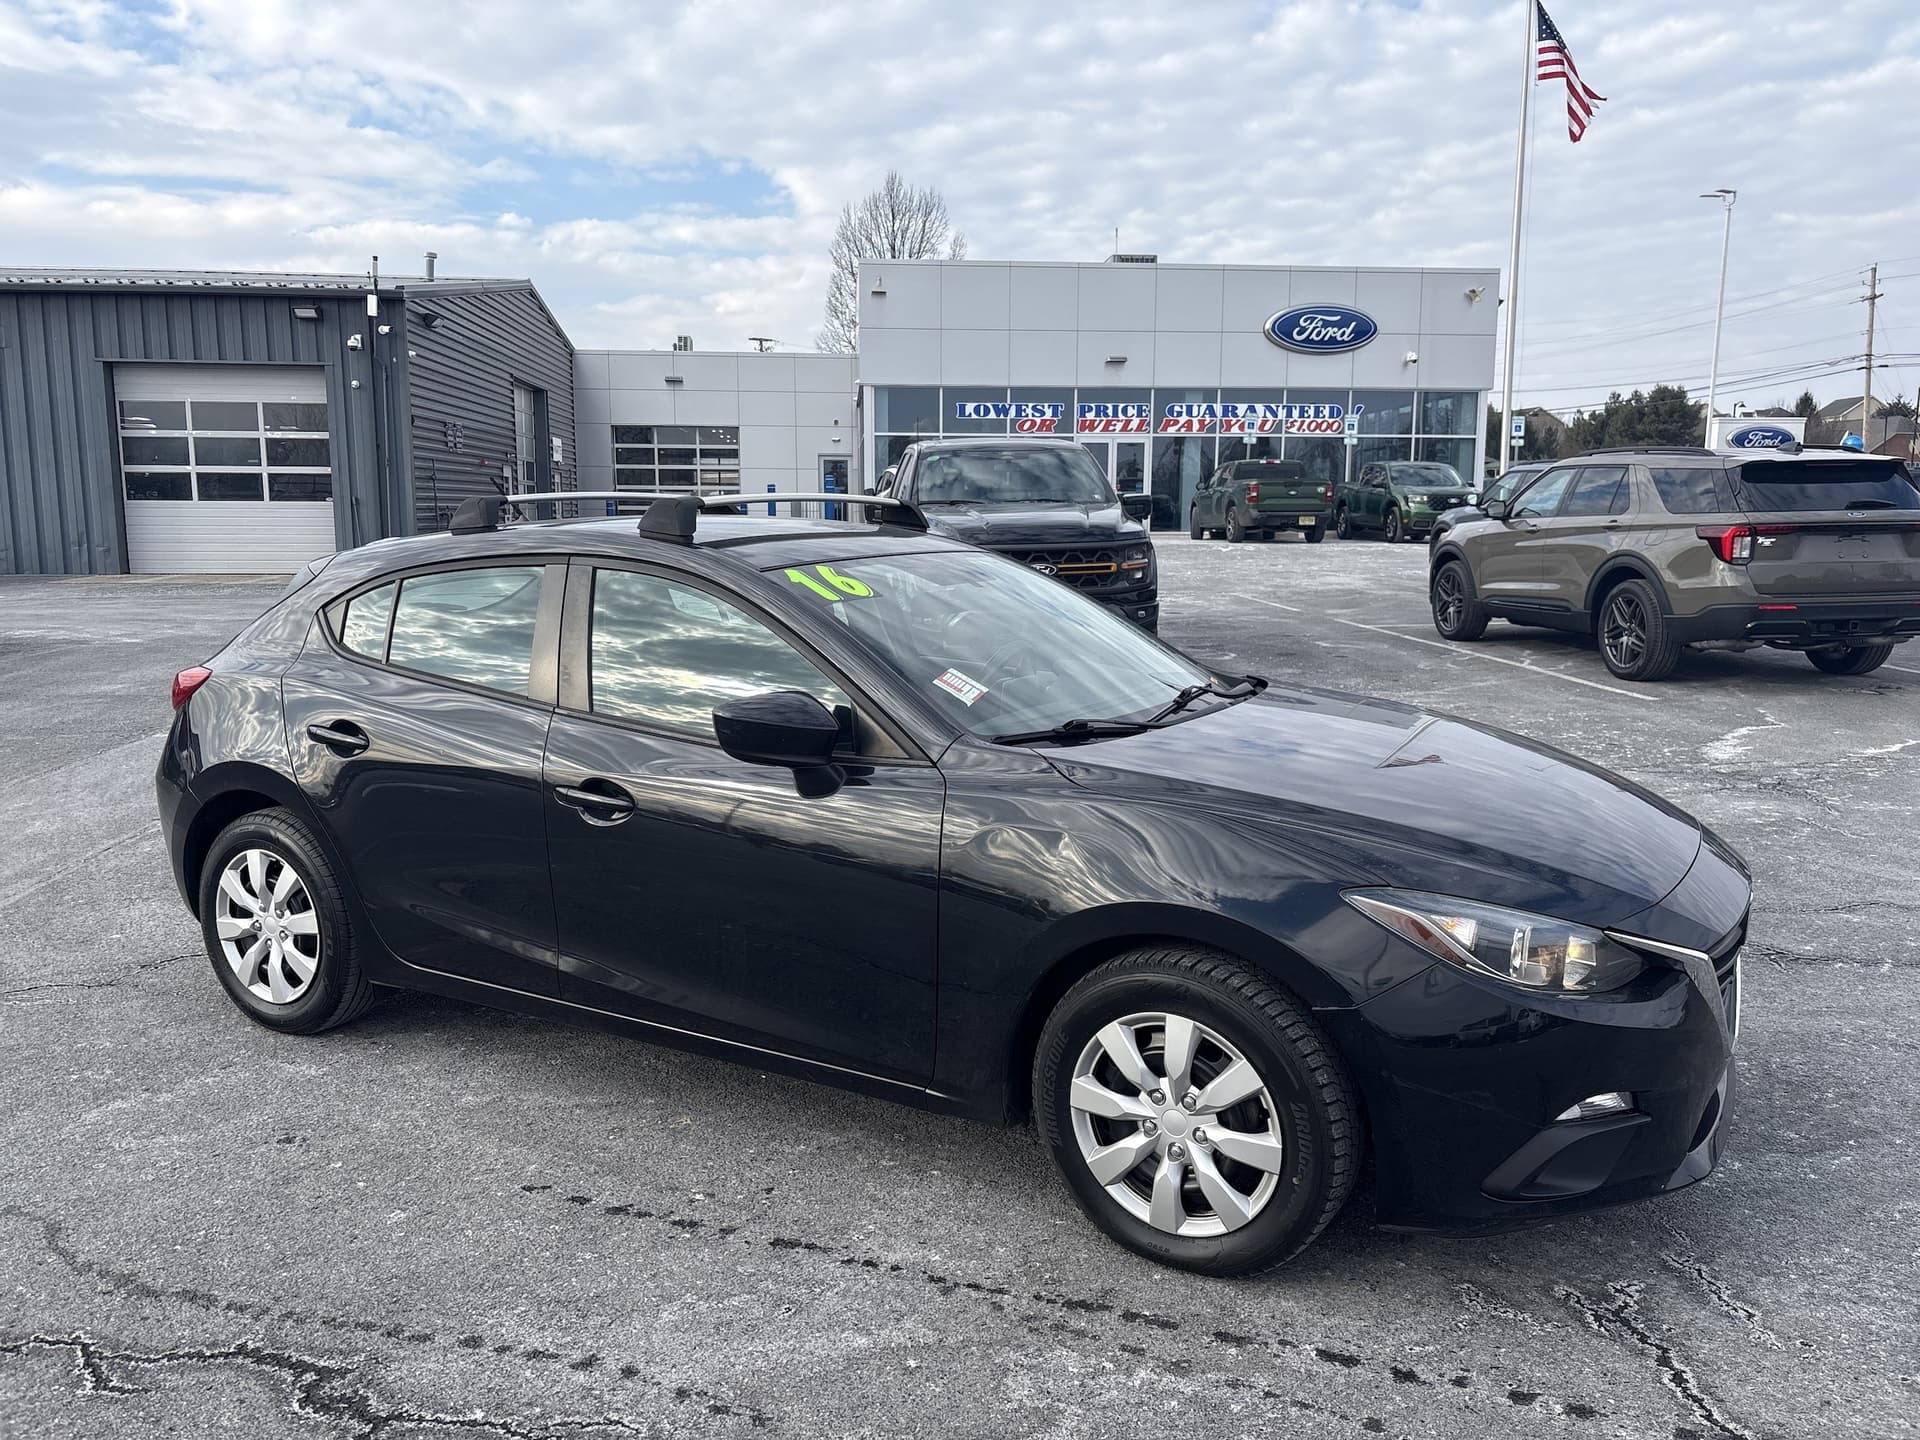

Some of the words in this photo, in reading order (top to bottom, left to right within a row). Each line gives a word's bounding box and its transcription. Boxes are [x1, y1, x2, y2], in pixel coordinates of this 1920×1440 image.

[1292, 314, 1357, 341] Ford
[957, 403, 1064, 418] LOWEST
[1078, 403, 1150, 418] PRICE
[1016, 418, 1057, 433] OR
[1159, 418, 1216, 433] PAY
[1744, 431, 1782, 447] Ford
[784, 565, 874, 601] 16
